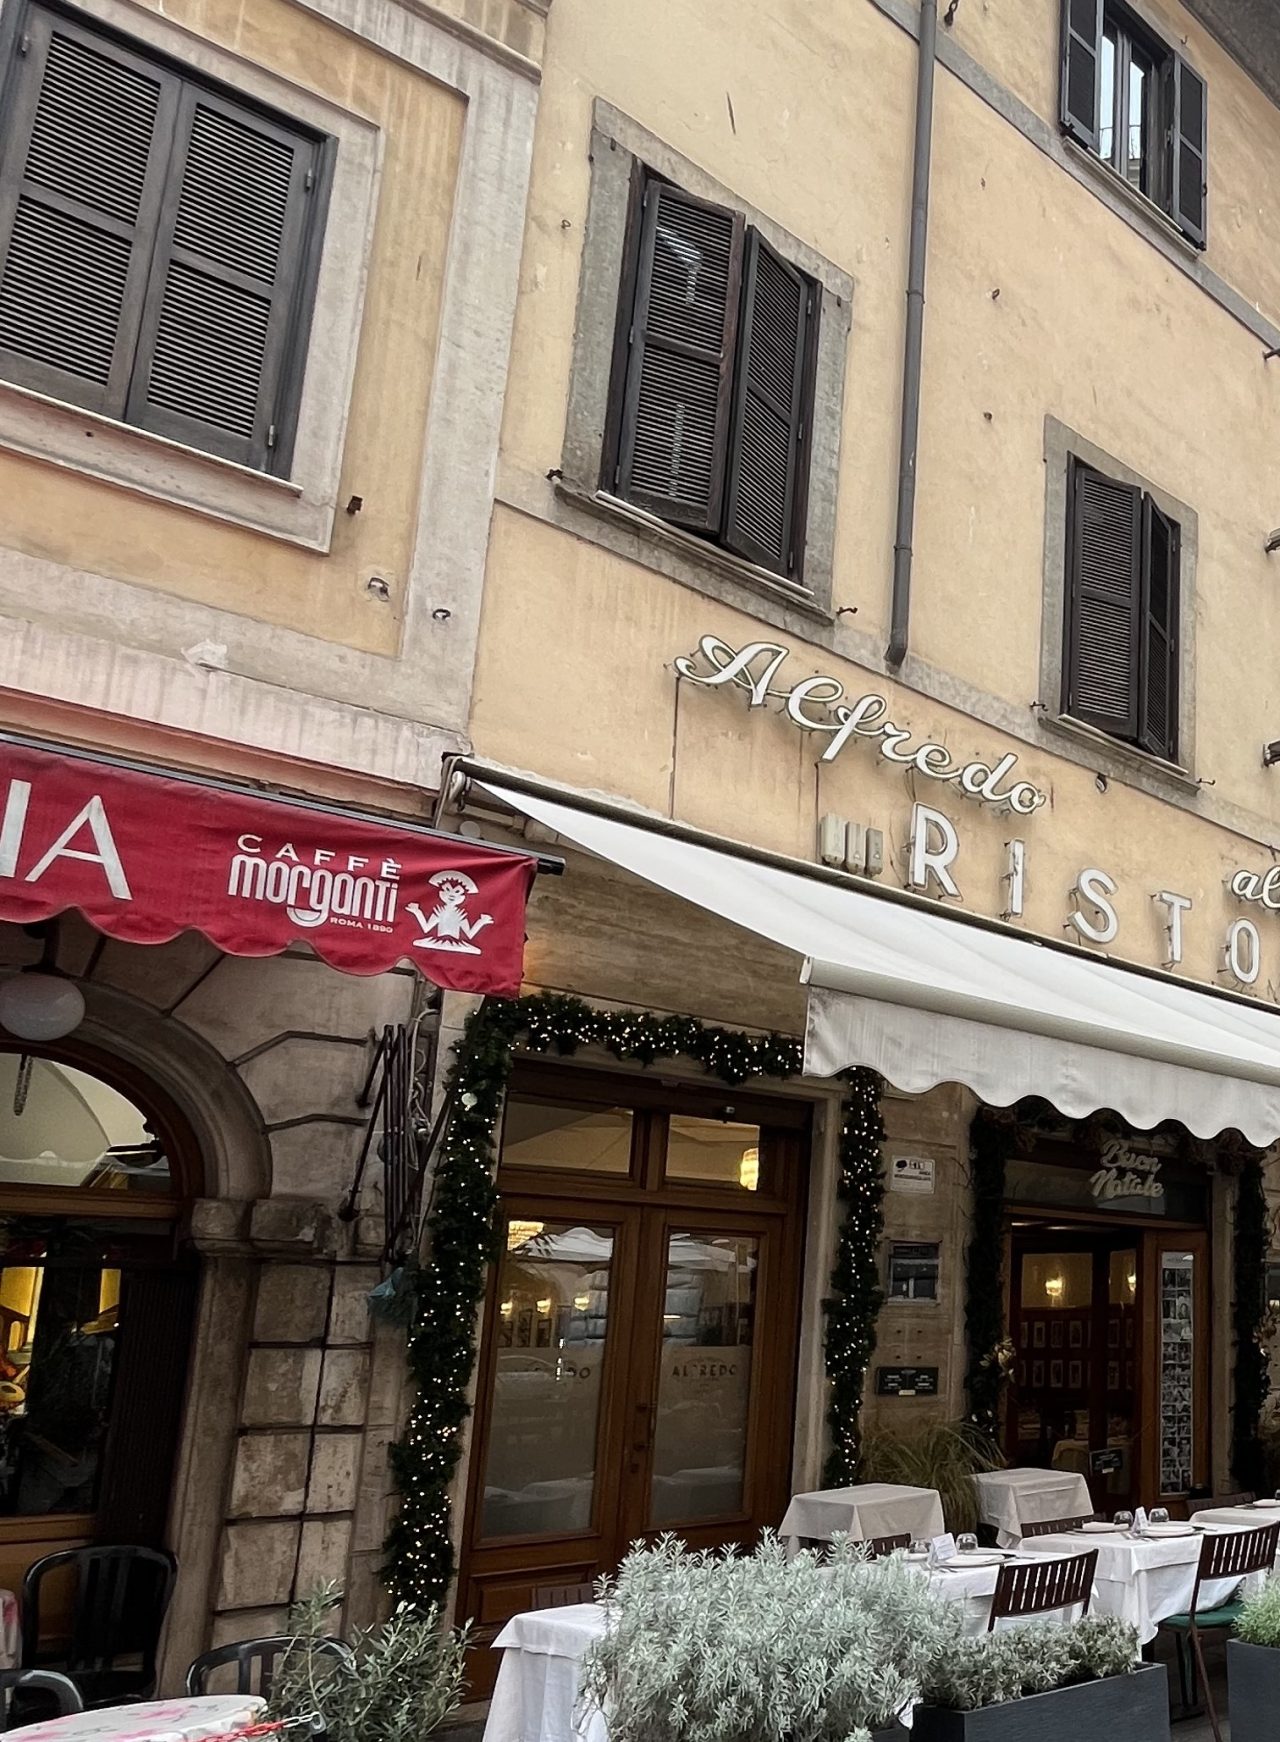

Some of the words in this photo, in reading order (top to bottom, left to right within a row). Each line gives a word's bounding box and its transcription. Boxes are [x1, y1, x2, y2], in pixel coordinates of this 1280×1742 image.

[674, 634, 1046, 815] Alfredo
[237, 833, 402, 880] CAFFÈ
[329, 917, 363, 929] ROMA
[367, 923, 394, 934] 1890
[1101, 1140, 1162, 1173] Buon
[1089, 1168, 1165, 1199] Natale
[672, 1364, 737, 1377] ALREDO
